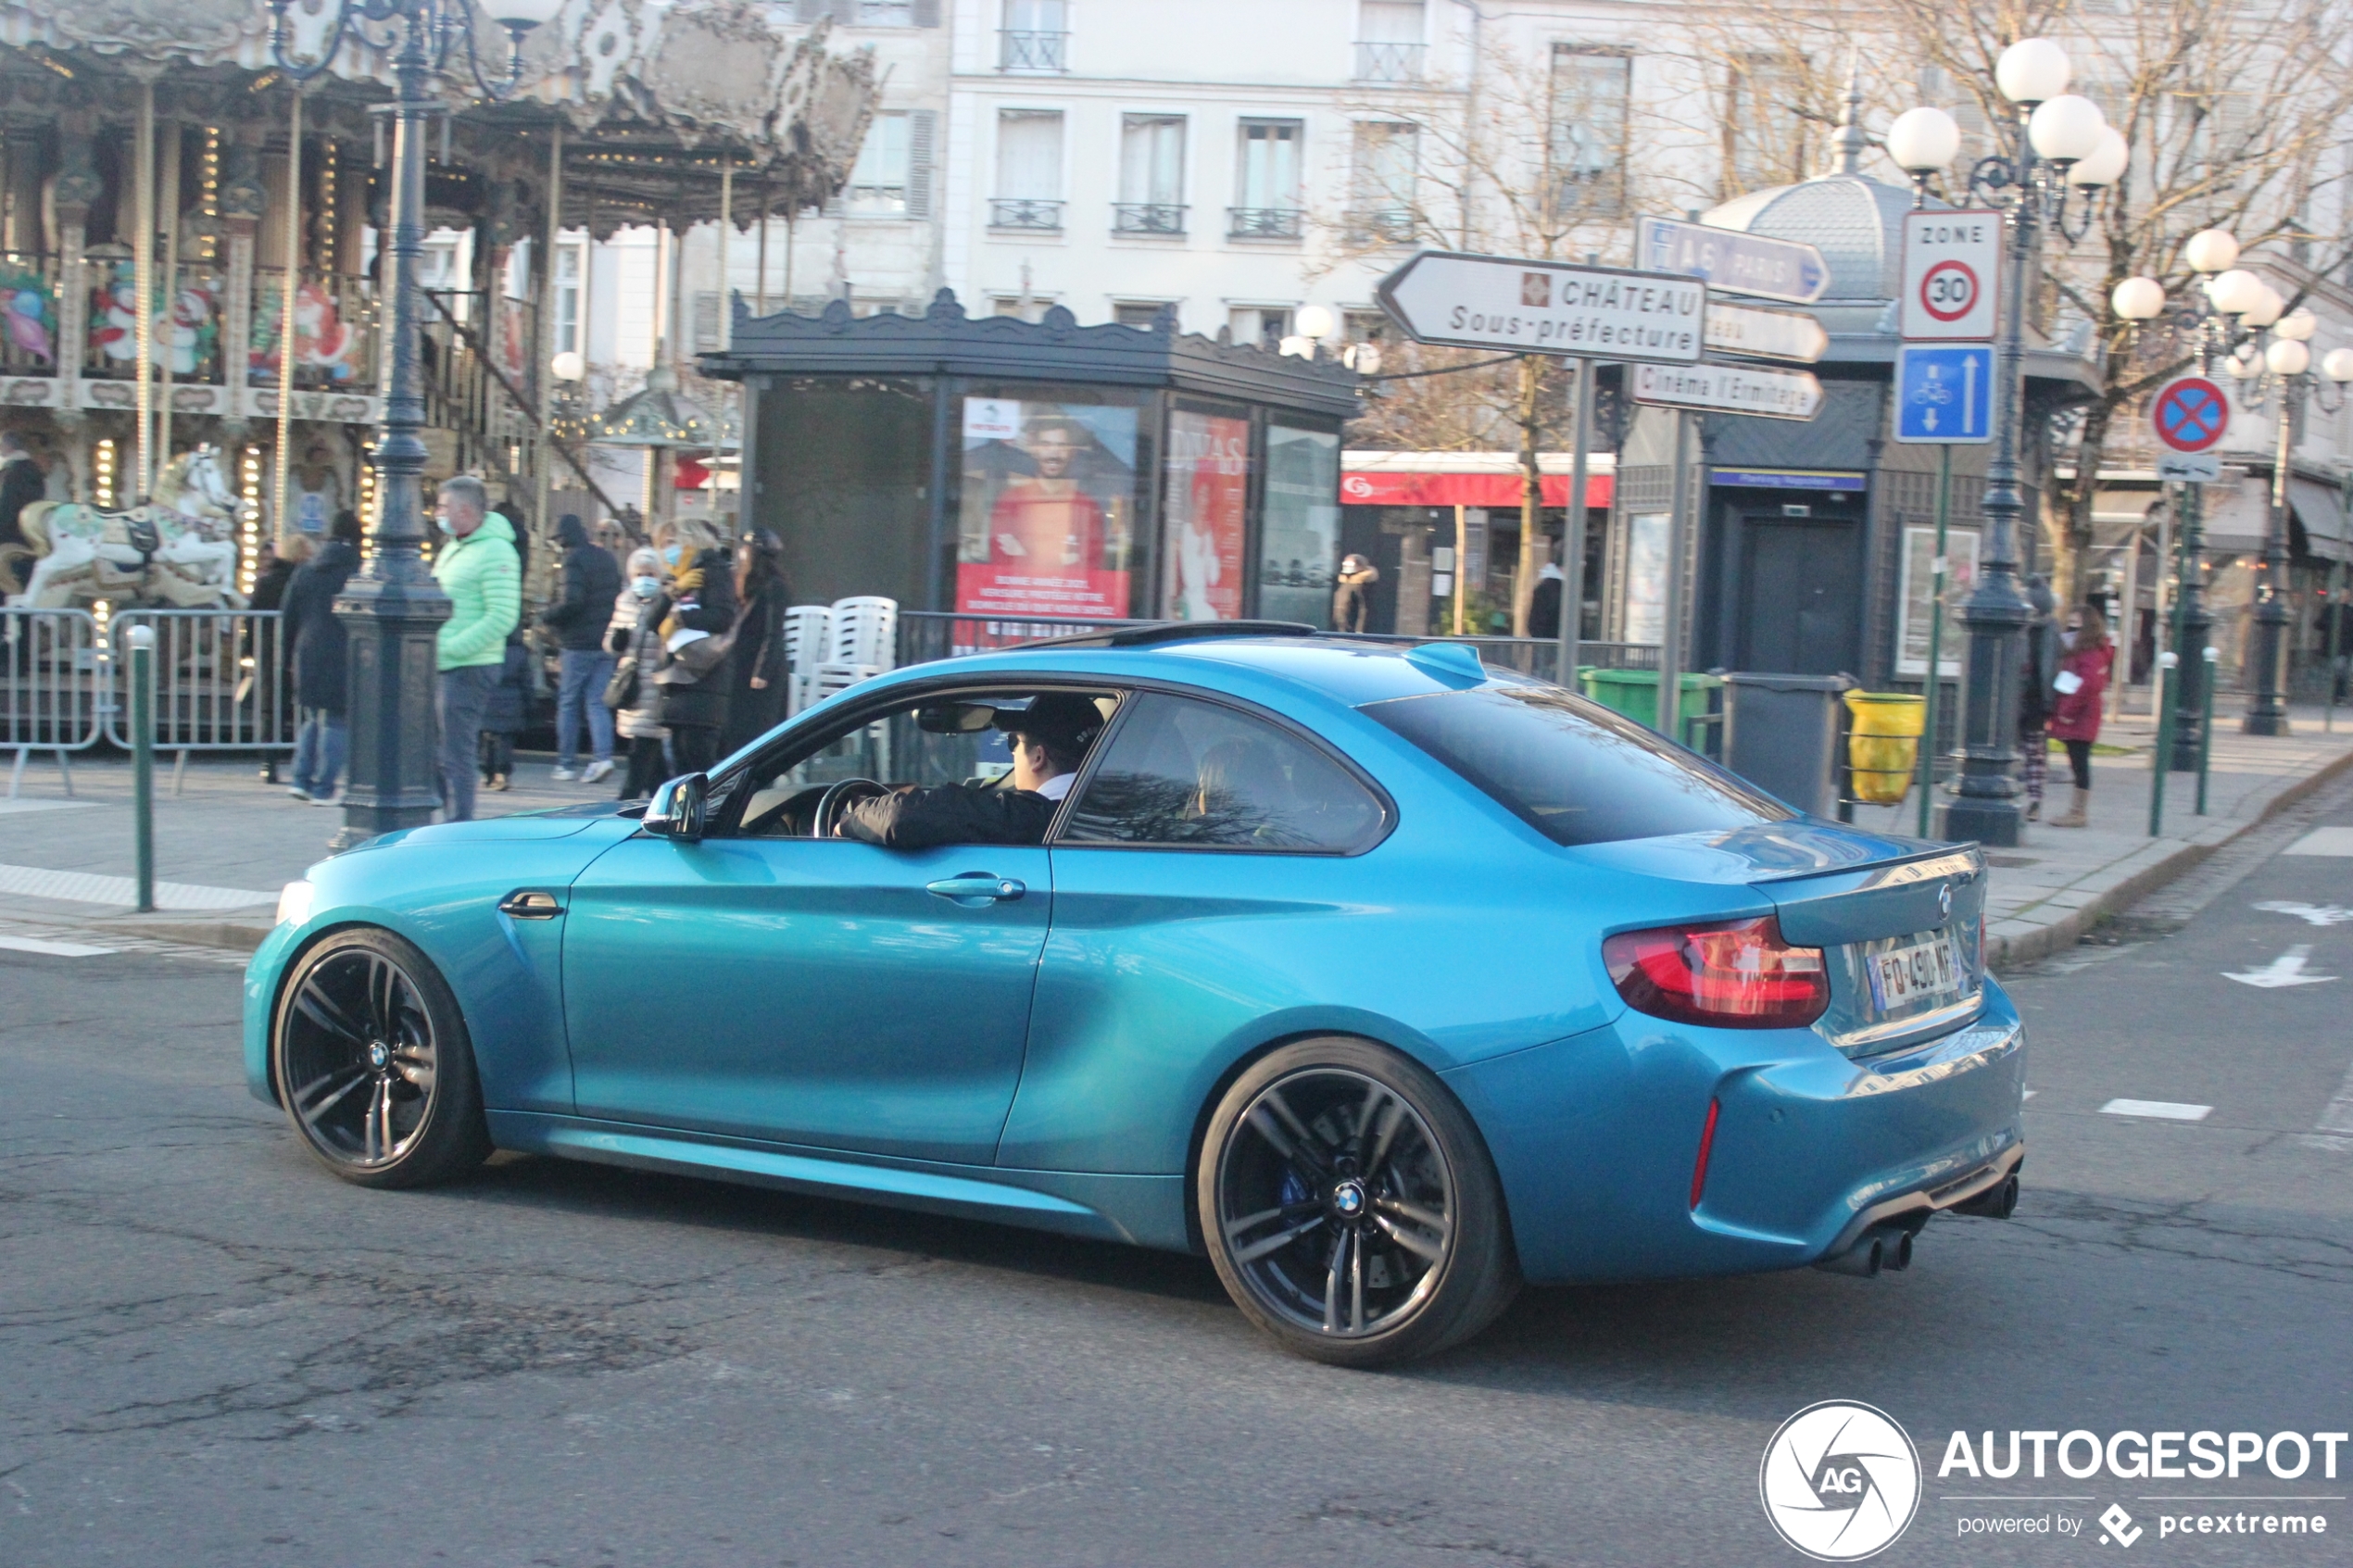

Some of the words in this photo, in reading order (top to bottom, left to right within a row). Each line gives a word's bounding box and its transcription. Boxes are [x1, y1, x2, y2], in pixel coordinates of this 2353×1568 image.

[1920, 226, 1984, 244] ZONE
[1561, 279, 1698, 316] CHÂTEAU
[1931, 277, 1968, 303] 30
[1449, 305, 1693, 350] Sous-préfecture
[1640, 366, 1711, 396] Cinéma
[1717, 374, 1807, 412] l'Ermitage
